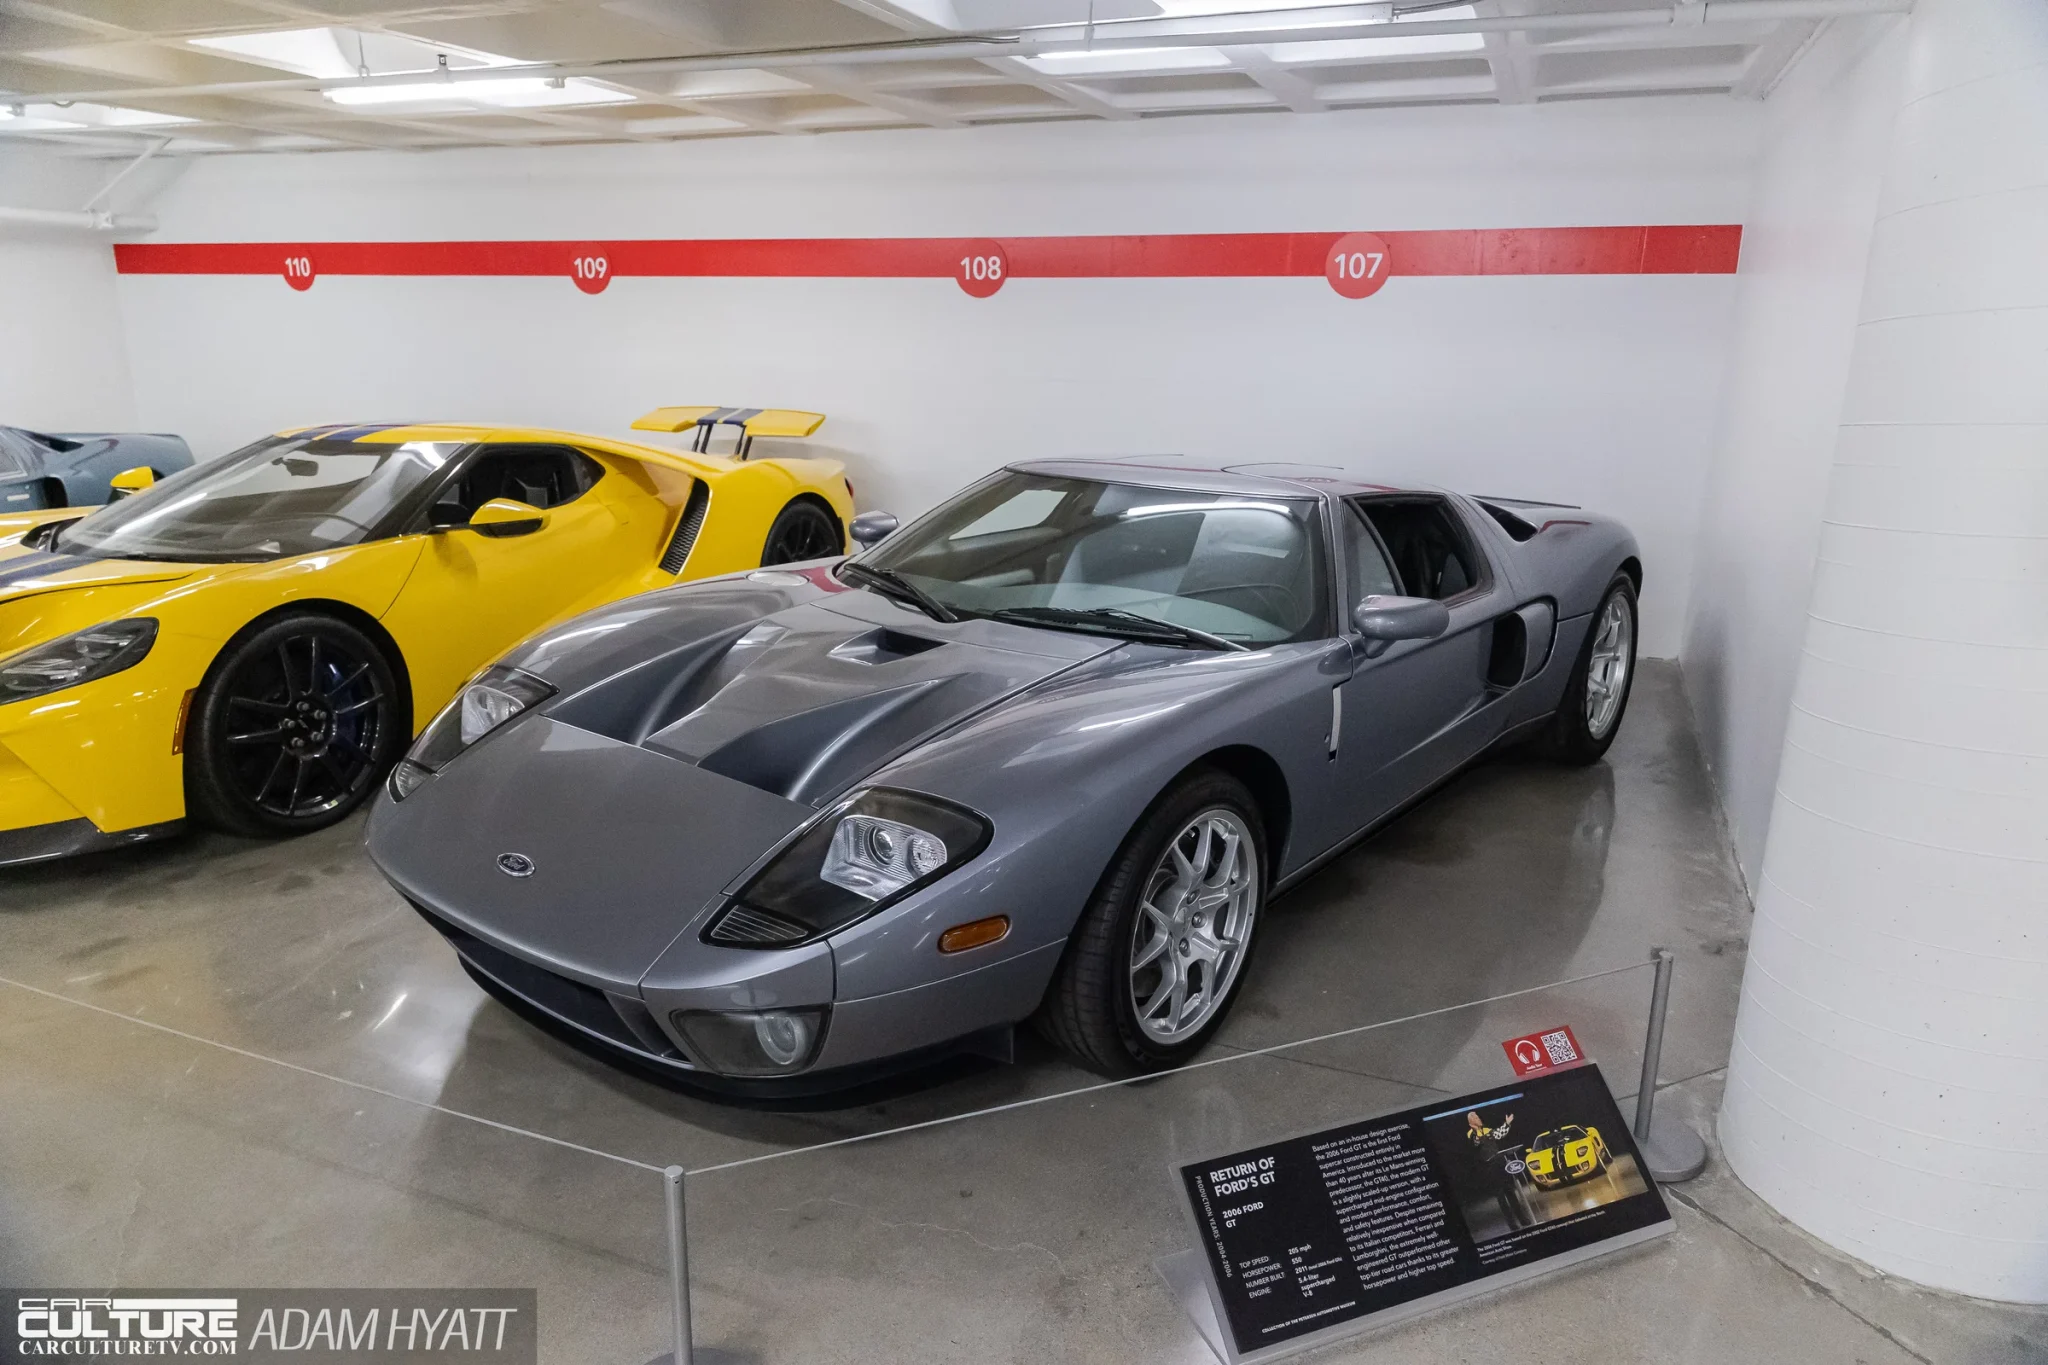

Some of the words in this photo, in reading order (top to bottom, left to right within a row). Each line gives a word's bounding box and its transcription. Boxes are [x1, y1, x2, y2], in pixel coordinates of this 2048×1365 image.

[285, 257, 310, 277] 110
[574, 257, 607, 279] 109
[960, 256, 1001, 280] 108
[1335, 253, 1383, 279] 107
[1312, 1143, 1330, 1152] Based
[1346, 1134, 1369, 1143] in-house
[1325, 1150, 1340, 1158] 2006
[1340, 1146, 1354, 1154] Ford
[1388, 1134, 1401, 1142] Ford
[1319, 1160, 1342, 1170] supercar
[1343, 1150, 1375, 1163] constructed
[1376, 1146, 1395, 1155] entirely
[1347, 1159, 1376, 1172] Introduced
[1393, 1151, 1411, 1160] market
[1210, 1162, 1258, 1183] RETURN
[1259, 1157, 1275, 1170] OF
[1347, 1175, 1362, 1184] years
[1390, 1157, 1426, 1170] Mans-winning
[1400, 1168, 1421, 1177] modern
[1215, 1176, 1258, 1197] FORD'S
[1260, 1171, 1275, 1184] GT
[1343, 1193, 1362, 1203] slightly
[1362, 1187, 1389, 1197] scaled-up
[1195, 1175, 1213, 1217] PRODUCTION
[1336, 1199, 1374, 1215] supercharged
[1374, 1192, 1404, 1204] mid-engine
[1405, 1183, 1439, 1195] configuration
[1223, 1208, 1242, 1218] 2006
[1243, 1202, 1264, 1213] FORD
[1340, 1216, 1351, 1224] and
[1351, 1211, 1373, 1220] modern
[1343, 1225, 1354, 1233] and
[1355, 1222, 1371, 1230] safety
[1395, 1209, 1416, 1218] Despite
[1416, 1201, 1443, 1212] remaining
[1226, 1219, 1236, 1228] GT
[1346, 1231, 1371, 1242] relatively
[1371, 1223, 1403, 1235] inexpensive
[1404, 1218, 1418, 1226] when
[1419, 1209, 1446, 1222] compared
[1364, 1239, 1381, 1247] Italian
[1415, 1224, 1433, 1232] Ferrari
[1434, 1219, 1444, 1228] and
[1288, 1247, 1299, 1255] 205
[1300, 1244, 1312, 1252] mph
[1400, 1235, 1426, 1248] extremely
[1357, 1256, 1389, 1271] engineered
[1389, 1253, 1397, 1261] GT
[1398, 1242, 1436, 1258] outperformed
[1436, 1239, 1450, 1247] other
[1360, 1270, 1381, 1280] top-tier
[1382, 1265, 1395, 1274] road
[1407, 1257, 1426, 1266] thanks
[1440, 1247, 1459, 1258] greater
[1295, 1265, 1307, 1274] 2011
[1298, 1274, 1319, 1284] 5.4-liter
[1363, 1276, 1396, 1290] horsepower
[1398, 1271, 1408, 1280] and
[1408, 1267, 1426, 1276] higher
[1246, 1277, 1270, 1288] NUMBER
[1301, 1276, 1336, 1293] supercharged
